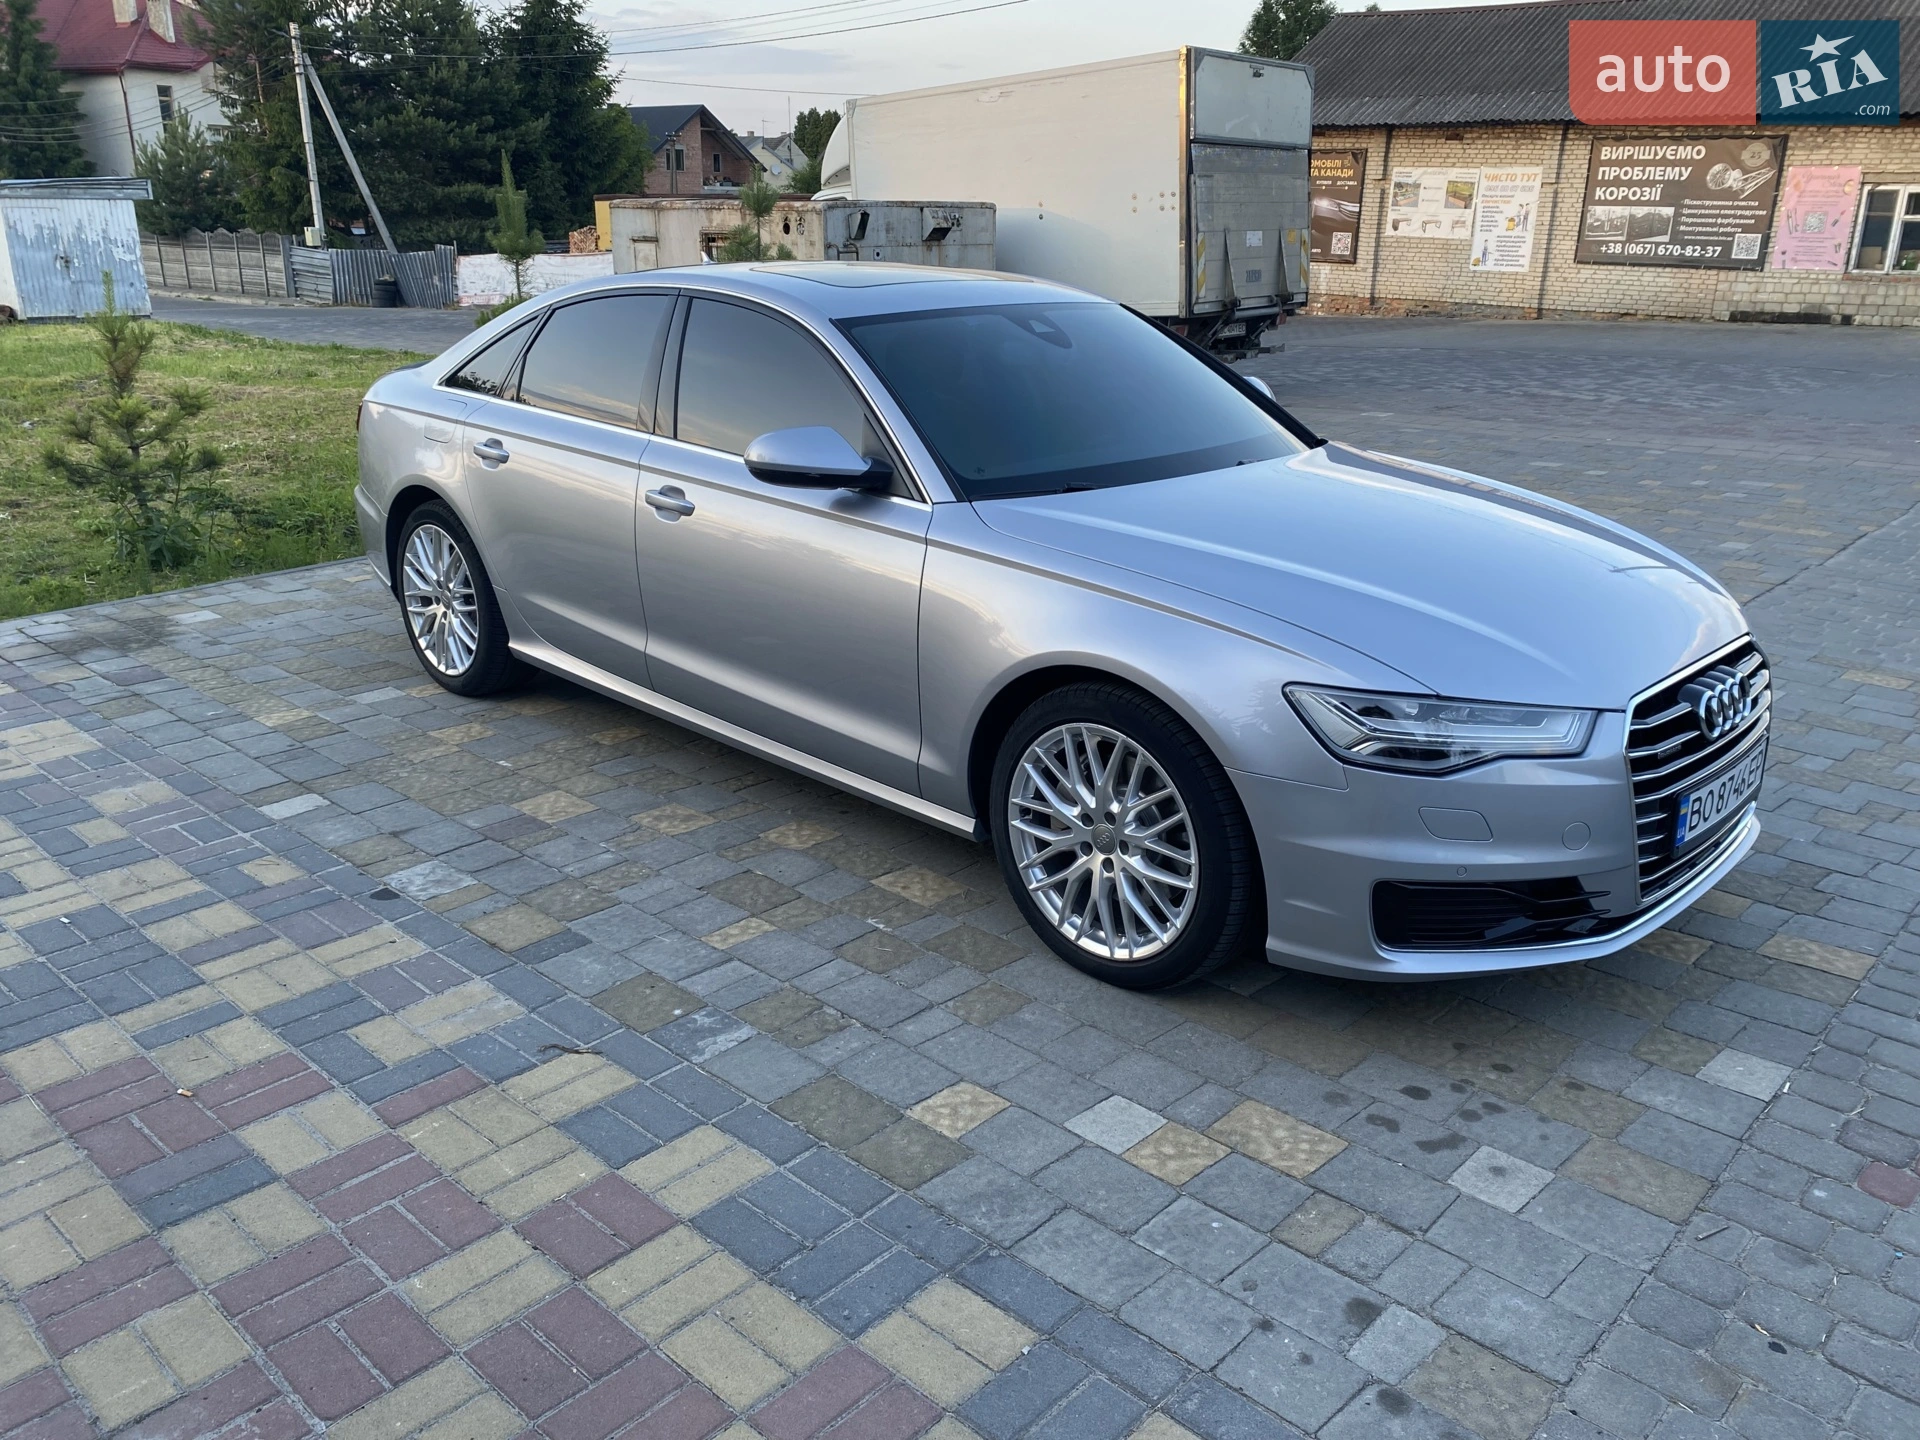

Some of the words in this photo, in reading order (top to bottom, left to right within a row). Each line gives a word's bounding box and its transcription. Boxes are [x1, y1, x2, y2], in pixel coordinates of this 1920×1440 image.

[1600, 145, 1707, 161] ВИРІШУЄМО
[1750, 151, 1762, 160] 25
[1320, 168, 1354, 178] КАНАДИ
[1484, 172, 1518, 182] ЧИСТО
[1520, 172, 1540, 182] ТУТ
[1597, 166, 1693, 182] ПРОБЛЕМУ
[1595, 184, 1664, 201] КОРОЗІЇ
[1683, 198, 1733, 207] Піскоструминна
[1682, 207, 1720, 216] Цинкування
[1720, 209, 1768, 217] електродугове
[1680, 216, 1716, 224] Порошкове
[1716, 217, 1756, 225] фарбування
[1679, 225, 1719, 233] Монтувальні
[1719, 225, 1742, 233] роботи
[1600, 242, 1623, 254] +38
[1624, 242, 1656, 257] (067)
[1657, 244, 1723, 258] 670-82-37
[1688, 788, 1715, 833] BO
[1716, 763, 1747, 814] 8746
[1747, 749, 1763, 788] EP
[1677, 828, 1686, 840] UA
